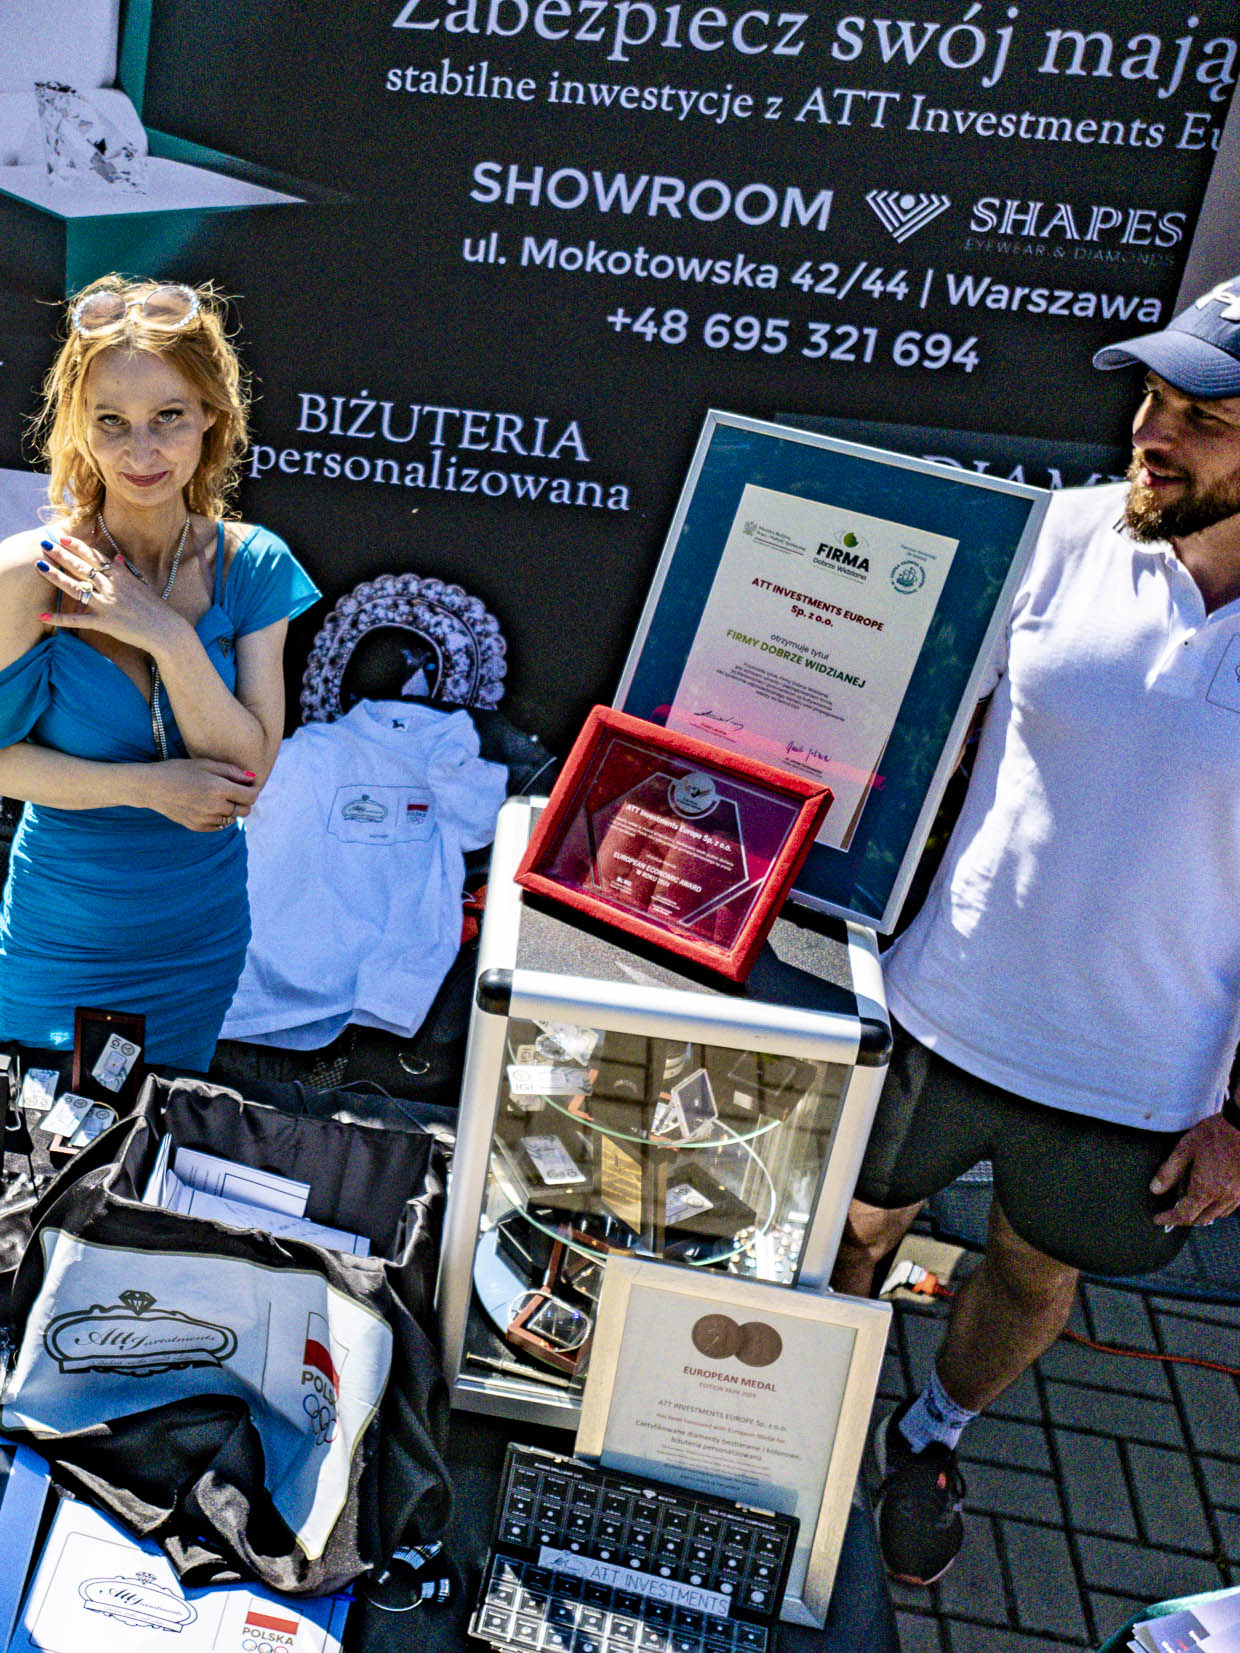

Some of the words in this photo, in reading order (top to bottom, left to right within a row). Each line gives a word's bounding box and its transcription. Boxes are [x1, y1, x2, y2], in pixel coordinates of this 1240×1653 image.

[392, 0, 809, 62] Zabezpiecz
[831, 3, 1019, 88] swój
[386, 57, 537, 101] stabilne
[547, 71, 754, 124] inwestycje
[764, 97, 783, 121] z
[794, 87, 900, 128] ATT
[906, 94, 1165, 148] Investments
[470, 161, 834, 231] SHOWROOM
[970, 197, 1187, 248] SHAPES
[462, 232, 506, 265] ul.
[520, 236, 779, 289] Mokotowska
[791, 260, 909, 300] 42/44
[946, 273, 1162, 324] Warszawa
[606, 305, 689, 345] +48
[703, 312, 790, 354] 695
[801, 320, 878, 363] 321
[892, 330, 980, 373] 694
[296, 389, 591, 462] BIŻUTERIA
[249, 441, 631, 511] personalizowana
[815, 542, 871, 573] FIRMA
[751, 577, 773, 591] ATT
[772, 584, 842, 617] INVESTMENTS
[843, 610, 885, 632] EUROPE
[790, 604, 806, 618] Sp.
[808, 613, 815, 621] z
[815, 614, 834, 628] o.o.
[726, 629, 760, 648] FIRMY
[760, 641, 803, 665] DOBRZE
[804, 658, 867, 689] WIDZIANEJ
[770, 633, 810, 653] otrzymuje
[683, 1366, 739, 1385] EUROPEAN
[740, 1377, 777, 1393] MEDAL
[673, 1402, 724, 1420] INVESTMENTS
[624, 1573, 730, 1616] INVESTMENTS
[241, 1626, 295, 1646] POLSKA
